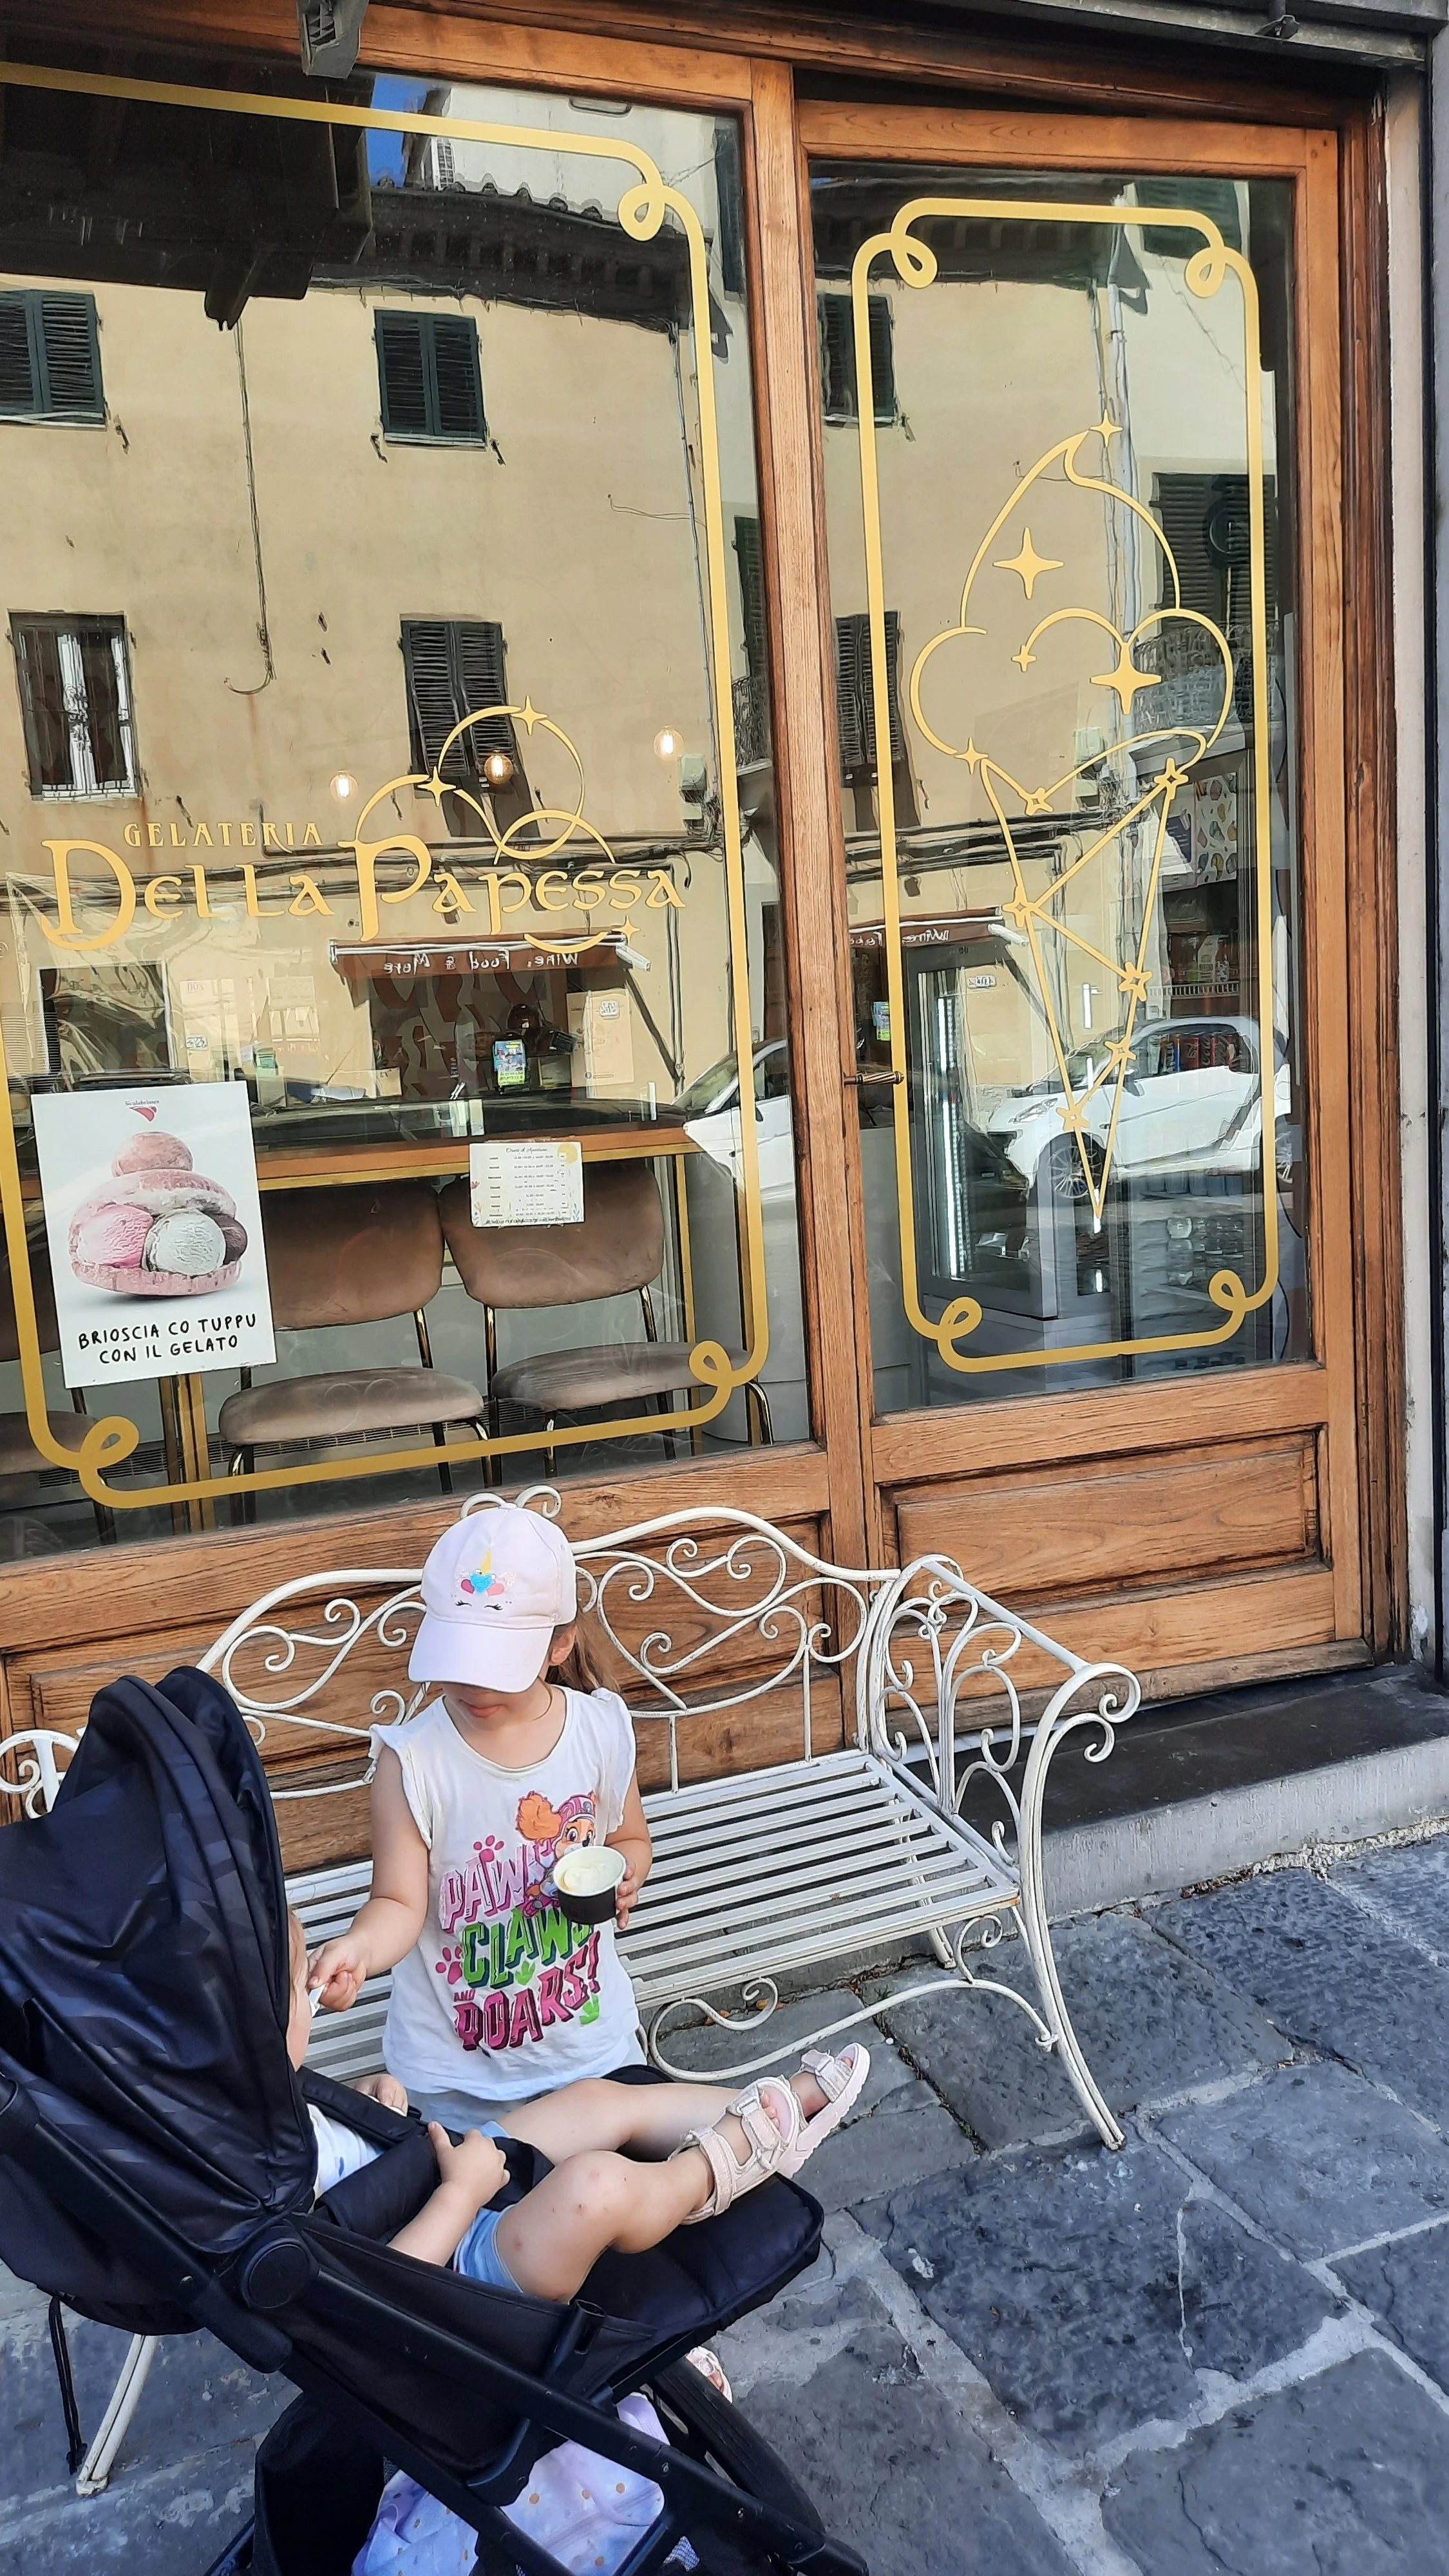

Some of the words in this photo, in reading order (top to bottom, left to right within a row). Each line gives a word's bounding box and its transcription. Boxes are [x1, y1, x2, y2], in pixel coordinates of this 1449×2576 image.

[124, 822, 323, 853] GELATERIA
[79, 1323, 160, 1350] BRIOSCIA
[168, 1321, 189, 1336] CO
[198, 1313, 257, 1333] TUPPU
[99, 1347, 138, 1364] CON
[146, 1344, 162, 1358] IL
[171, 1335, 238, 1356] GELATO
[453, 1988, 476, 2002] AND
